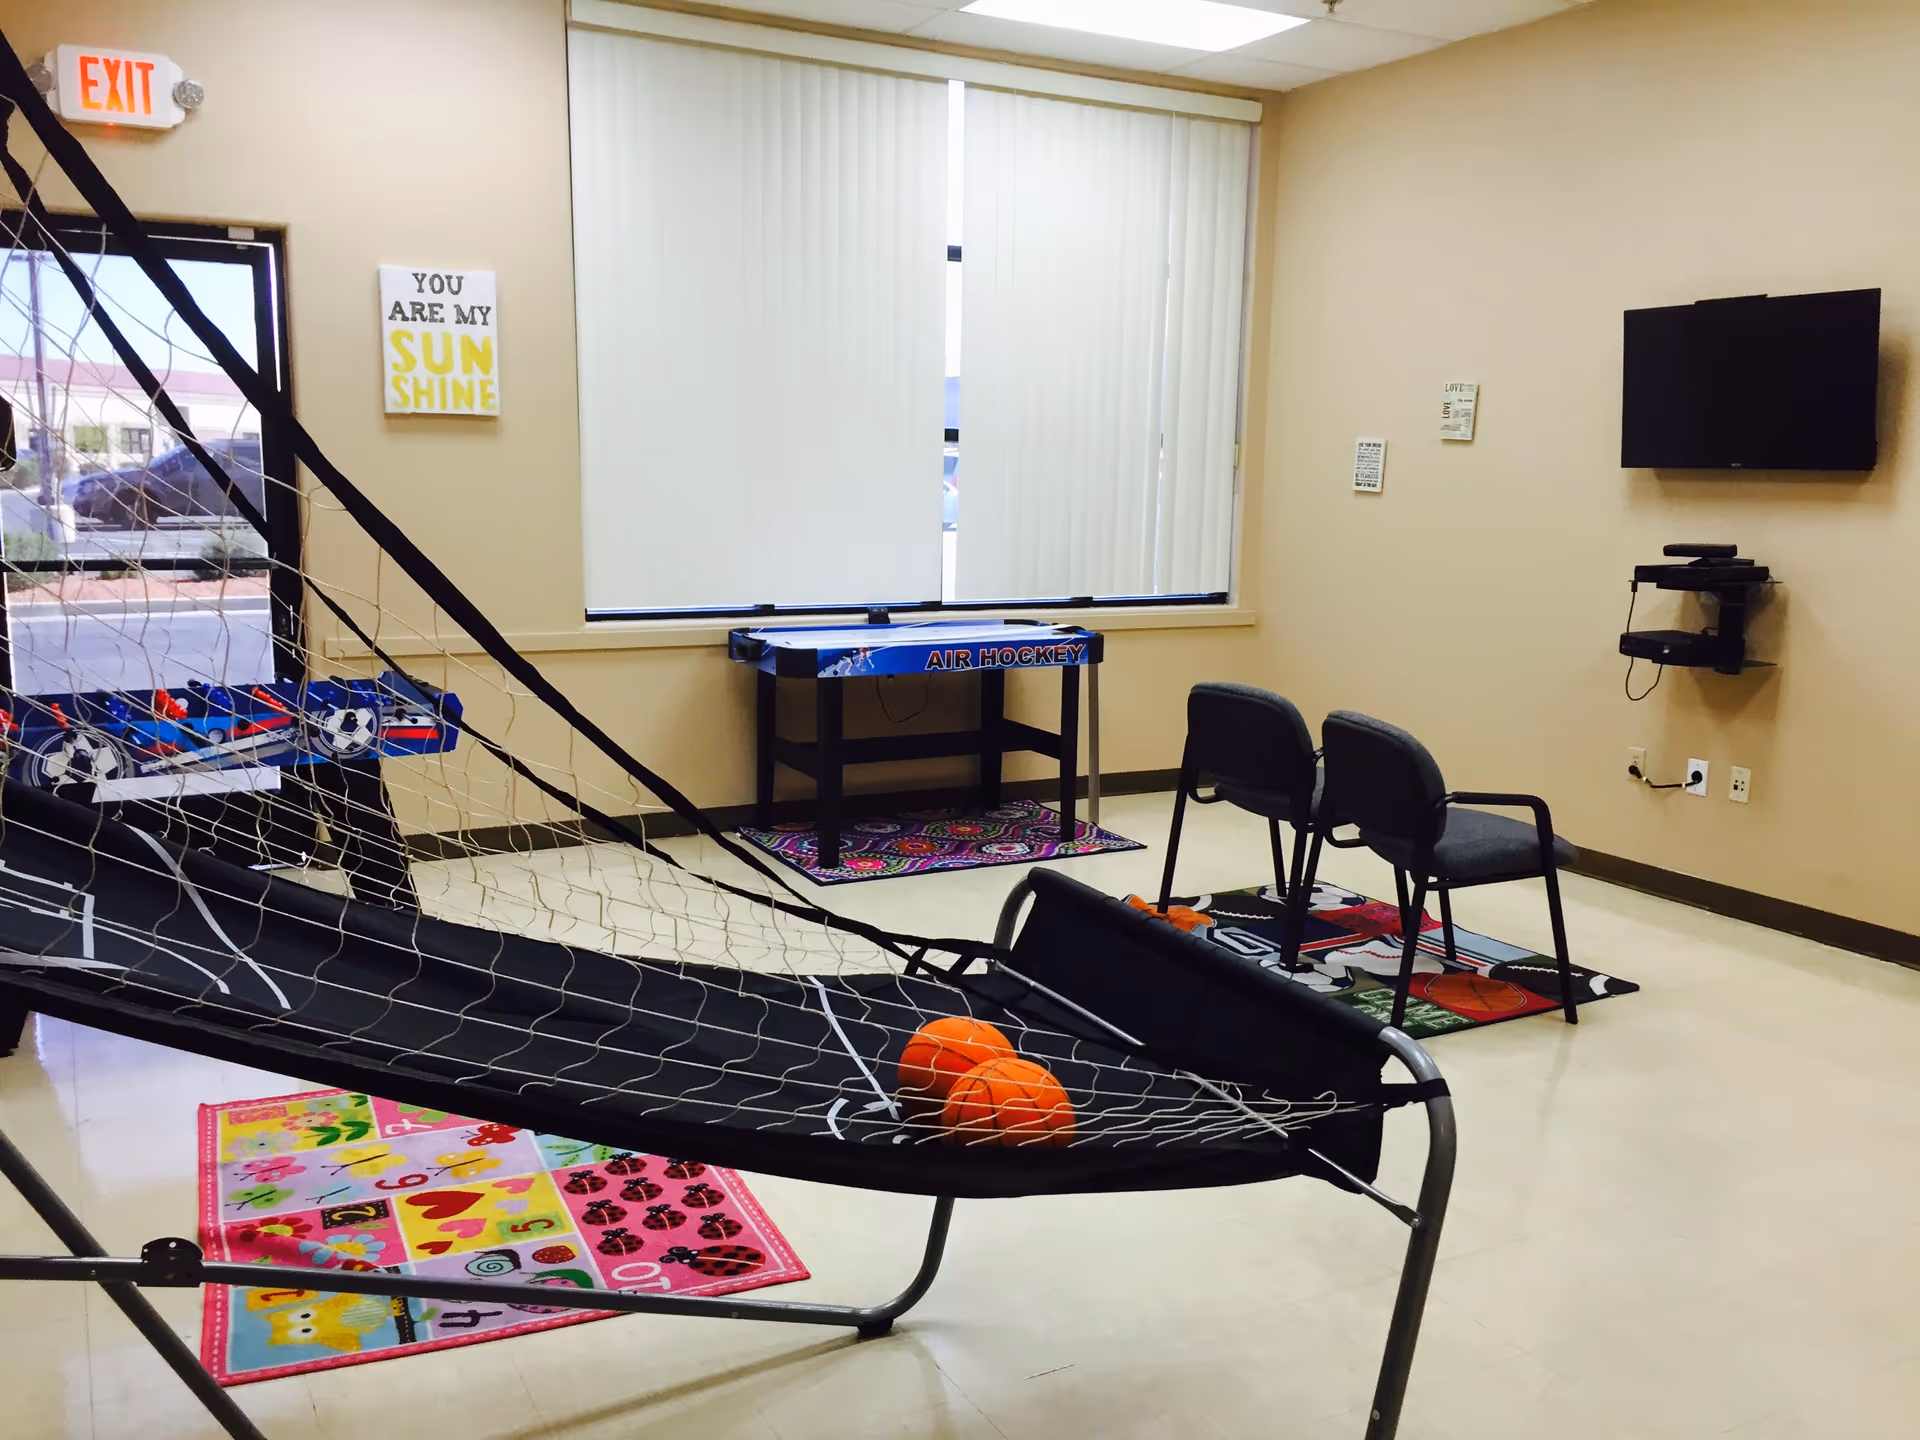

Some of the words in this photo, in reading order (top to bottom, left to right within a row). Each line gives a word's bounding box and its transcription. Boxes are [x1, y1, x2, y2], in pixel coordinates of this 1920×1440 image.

[80, 56, 154, 115] EXIT
[411, 272, 464, 295] YOU
[388, 300, 445, 323] ARE
[453, 304, 491, 326] MY
[390, 329, 493, 376] SUN
[391, 375, 497, 411] SHINE
[1445, 383, 1464, 392] LOVE
[1442, 401, 1452, 419] LOVE
[925, 650, 972, 670] AIR
[980, 644, 1085, 666] HOCKEY
[331, 1205, 377, 1221] 2
[510, 1218, 554, 1233] 5
[438, 1309, 503, 1328] 4
